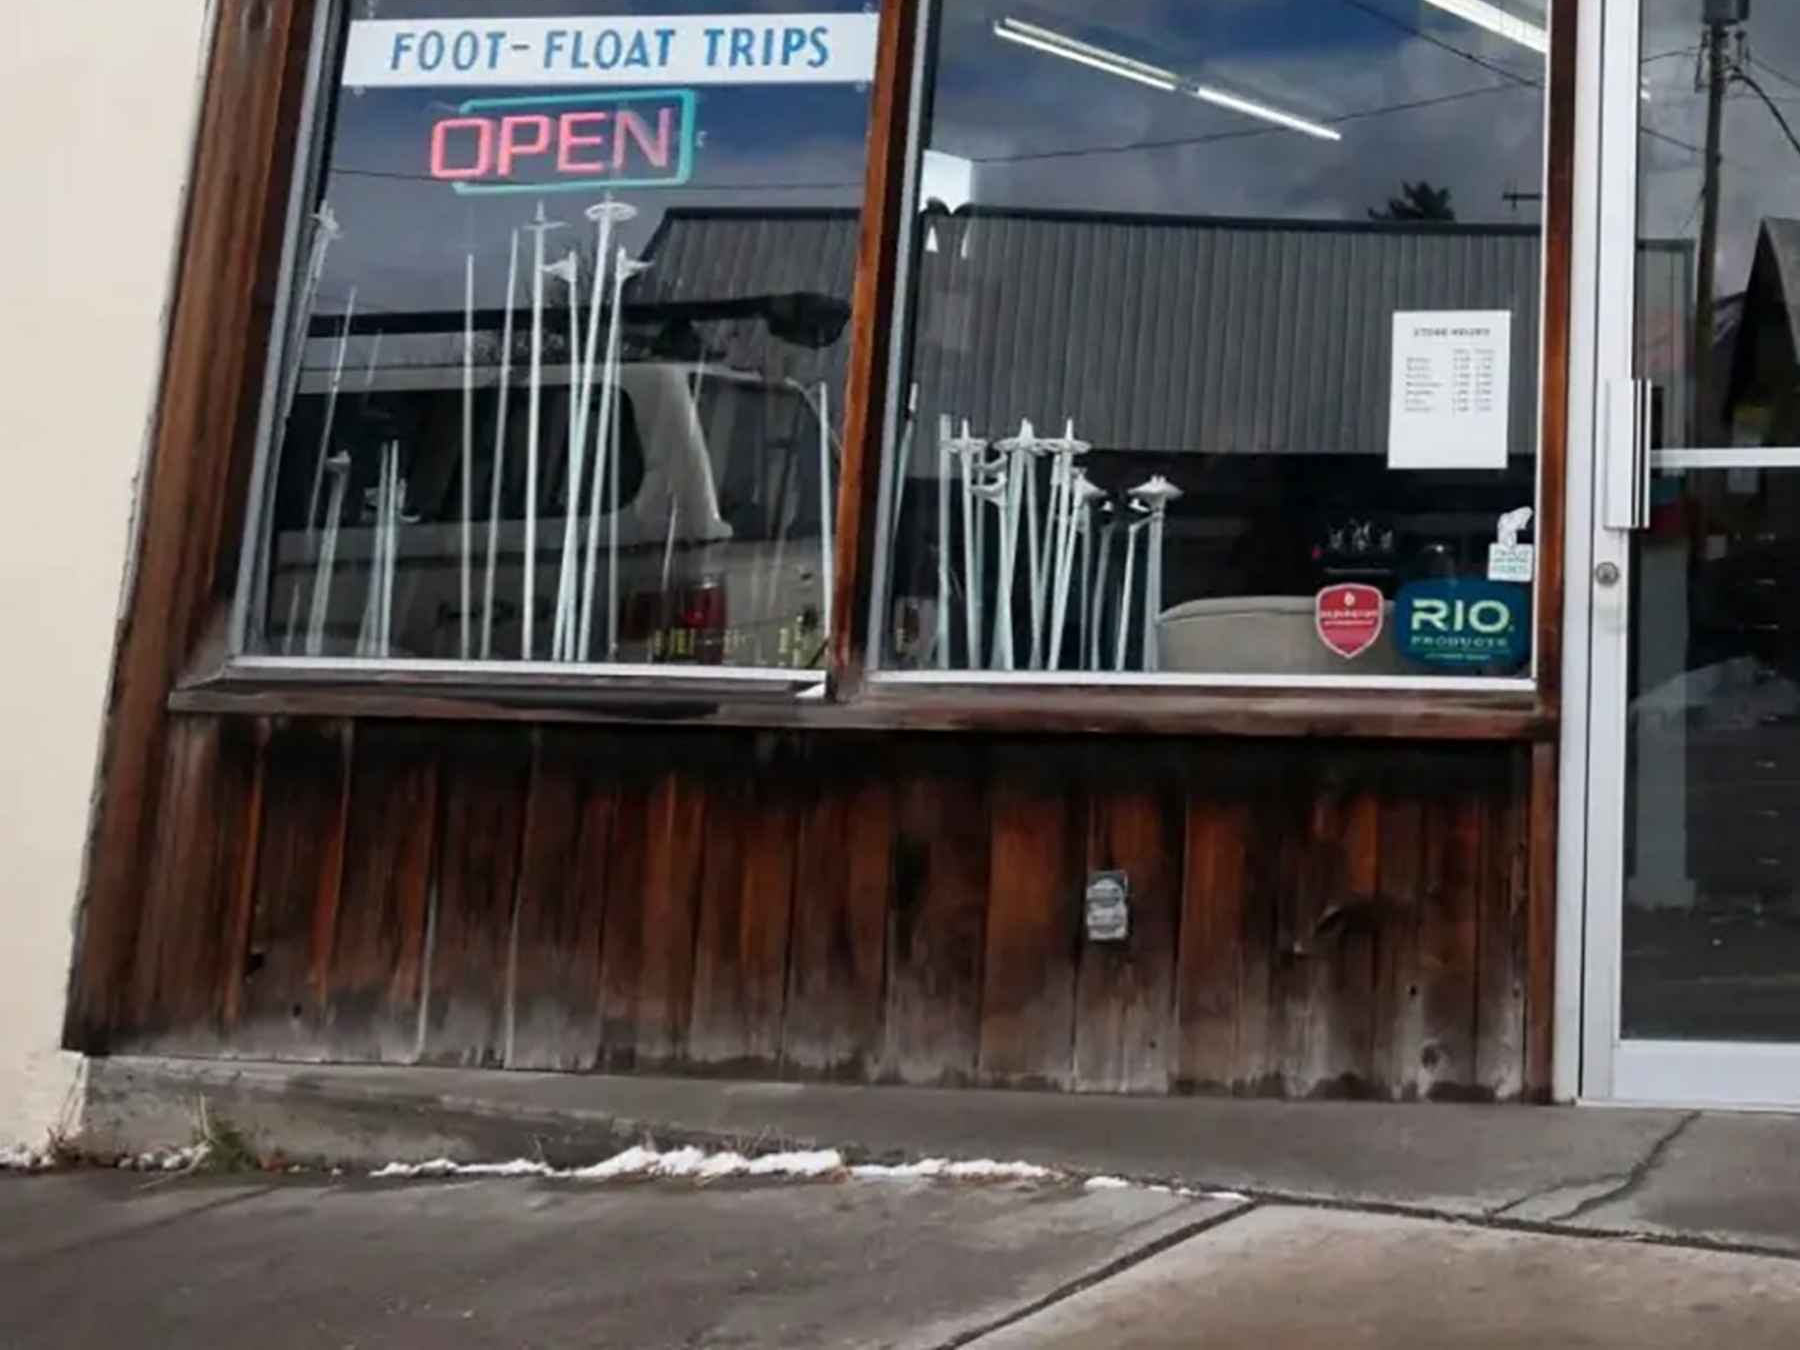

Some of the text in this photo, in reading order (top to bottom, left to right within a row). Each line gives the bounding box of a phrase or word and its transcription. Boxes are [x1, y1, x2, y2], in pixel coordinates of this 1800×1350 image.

[704, 26, 831, 69] TRIPS
[430, 107, 674, 179] OPEN
[1411, 599, 1511, 633] RIO
